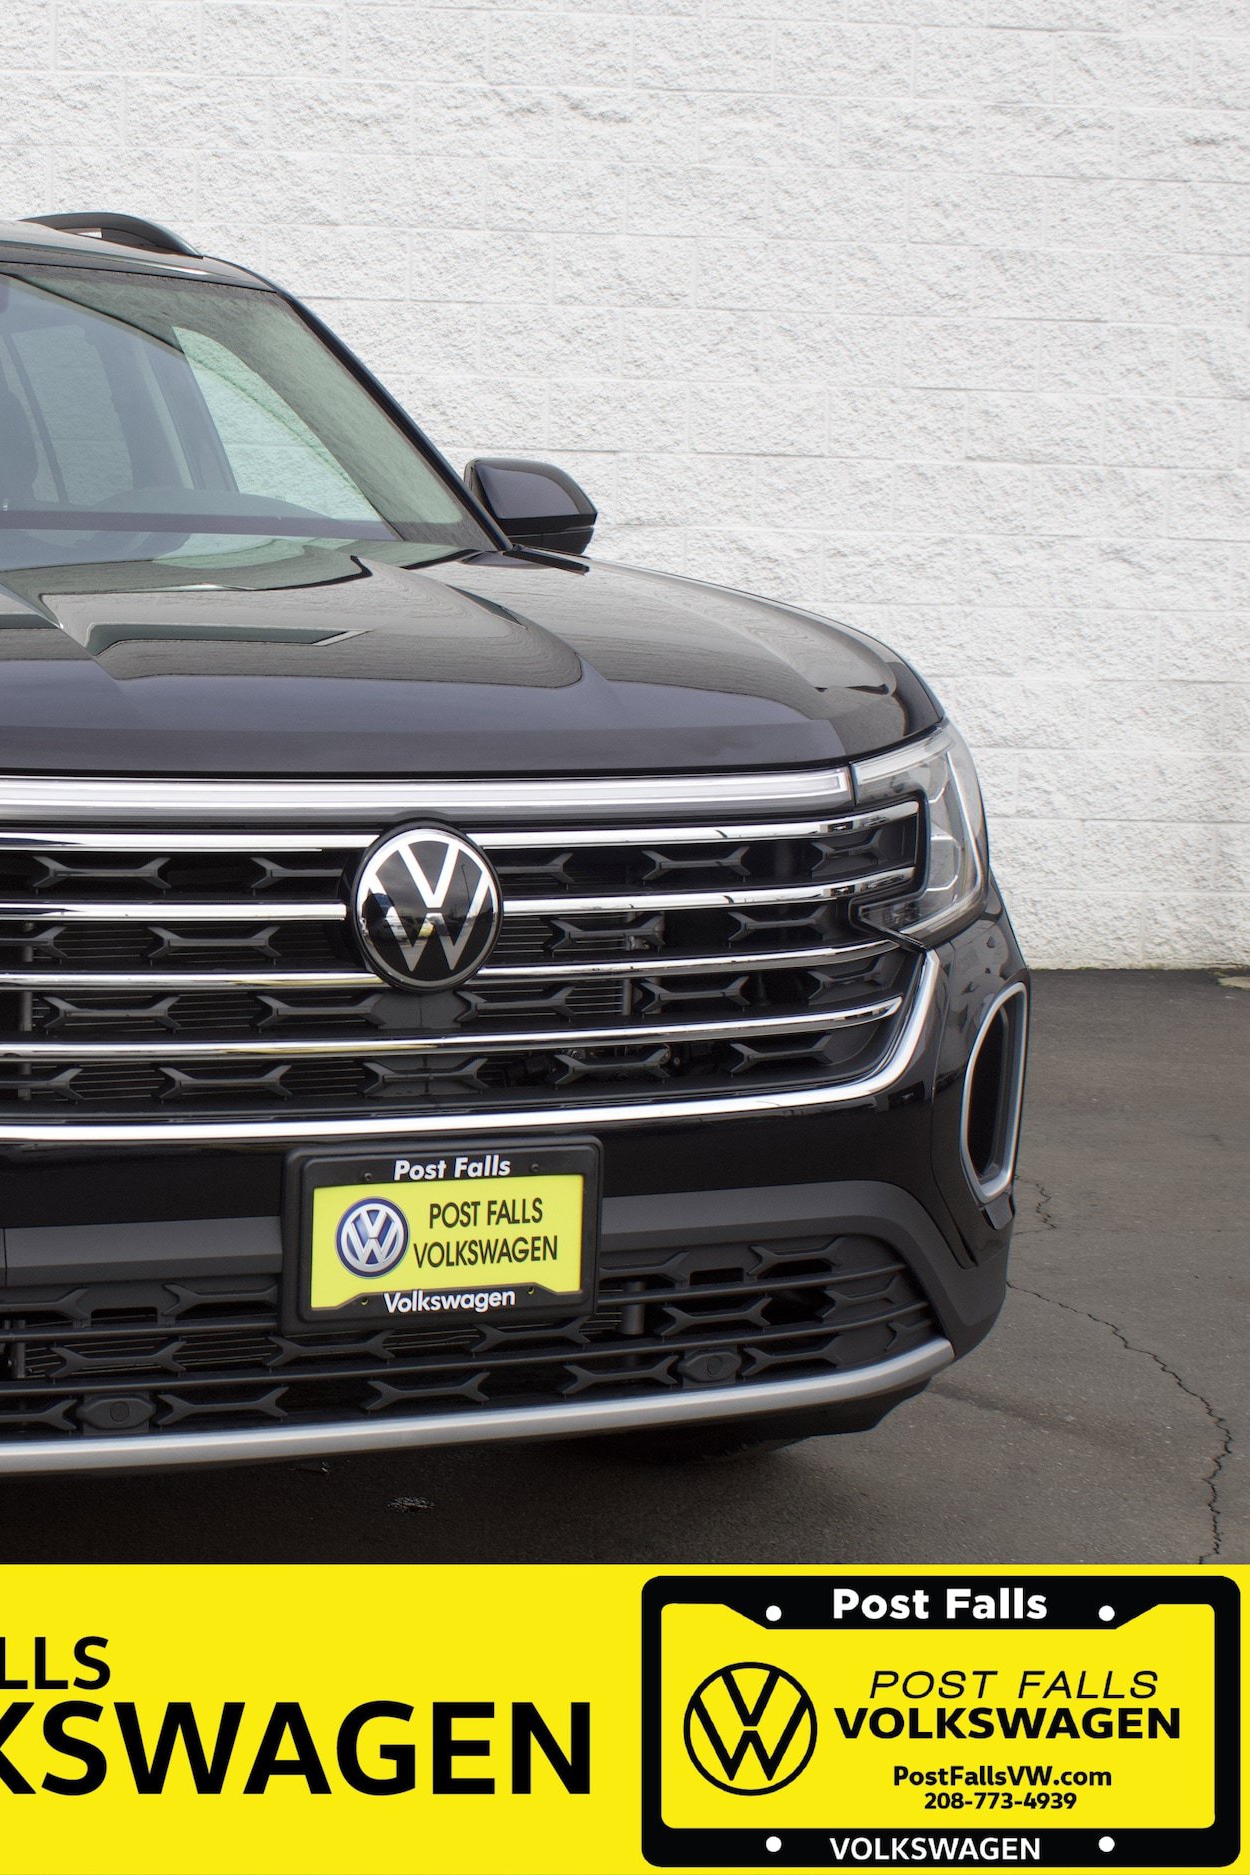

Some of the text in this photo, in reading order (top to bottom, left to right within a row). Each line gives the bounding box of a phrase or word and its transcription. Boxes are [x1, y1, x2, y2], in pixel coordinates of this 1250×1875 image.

[356, 828, 499, 988] VW
[393, 1154, 511, 1181] Post Falls
[429, 1197, 543, 1229] POST FALLS
[337, 1198, 408, 1277] VW
[413, 1235, 558, 1269] VOLKSWAGEN
[383, 1289, 516, 1314] Volkswagen
